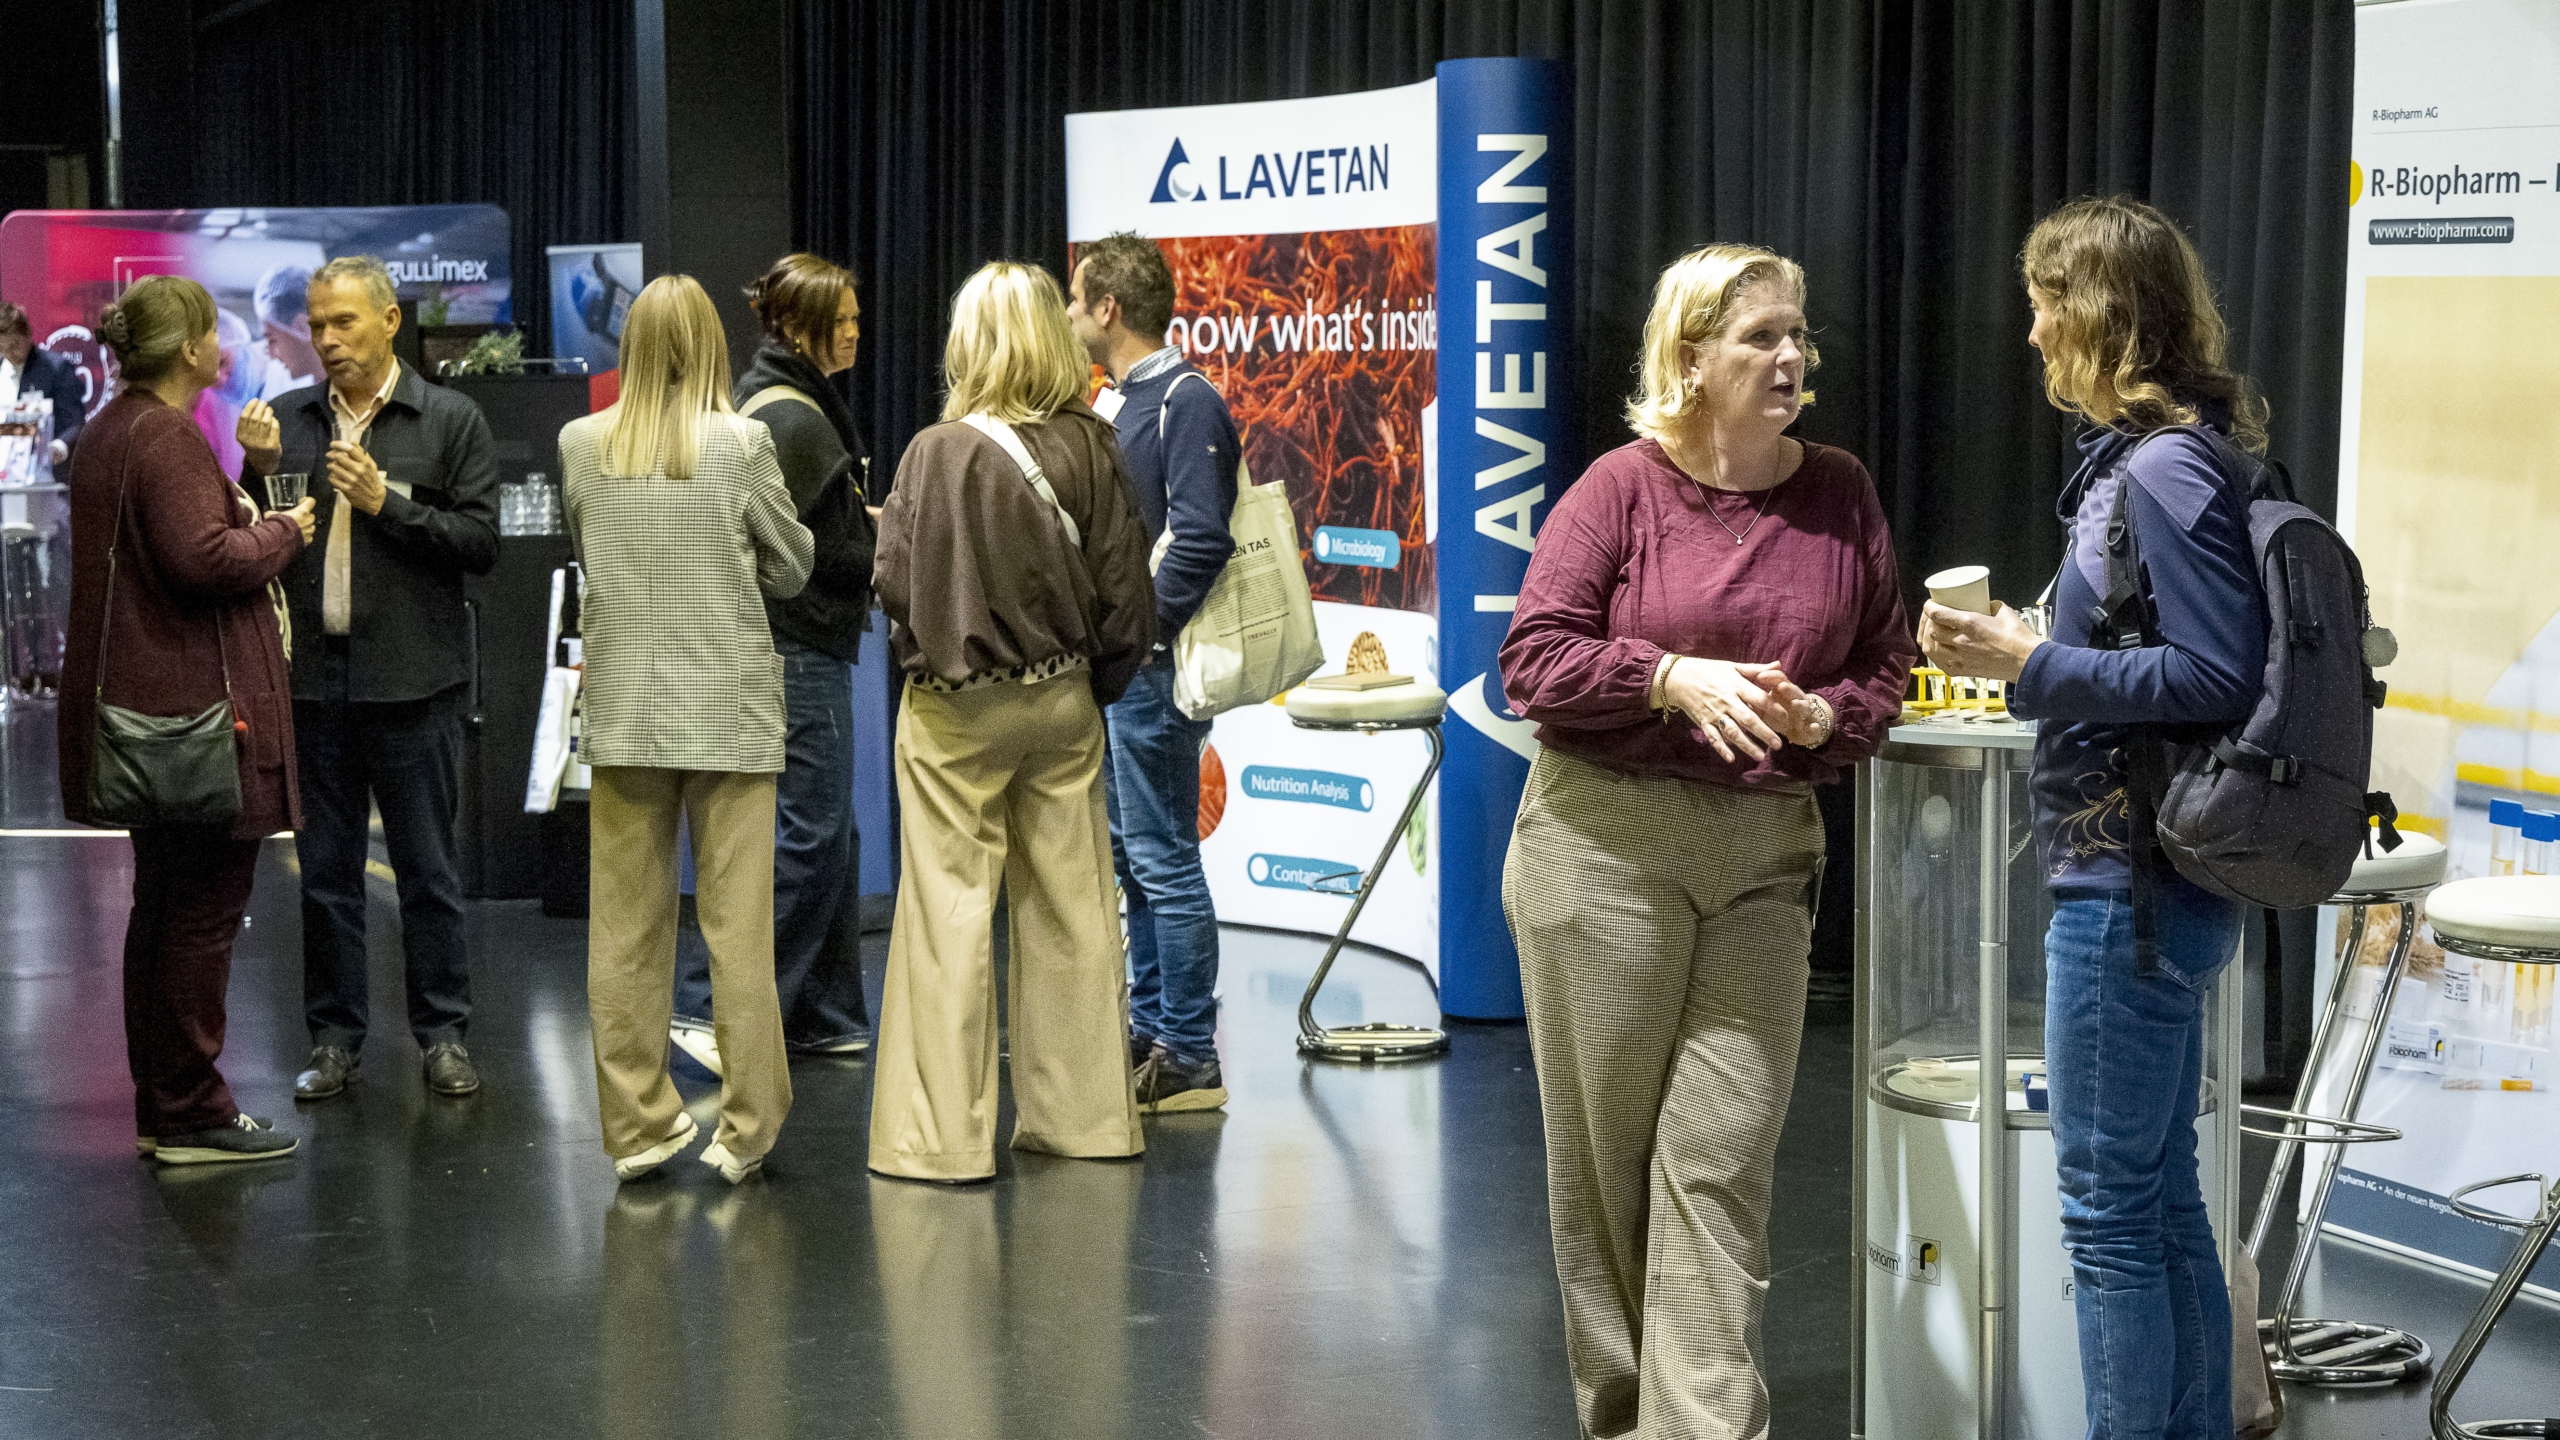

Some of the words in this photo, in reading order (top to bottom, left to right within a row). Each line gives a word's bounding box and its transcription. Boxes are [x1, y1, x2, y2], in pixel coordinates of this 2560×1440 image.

[2372, 108, 2423, 124] R-Biopharm
[2425, 106, 2439, 119] AG
[1219, 143, 1389, 200] LAVETAN
[2371, 164, 2521, 205] R-Biopharm
[2373, 222, 2508, 242] www.r-biopharm.com
[1165, 314, 1259, 354] now
[1331, 537, 1386, 563] Microbiology
[1251, 774, 1310, 795] Nutrition
[1310, 779, 1350, 802] Analysis
